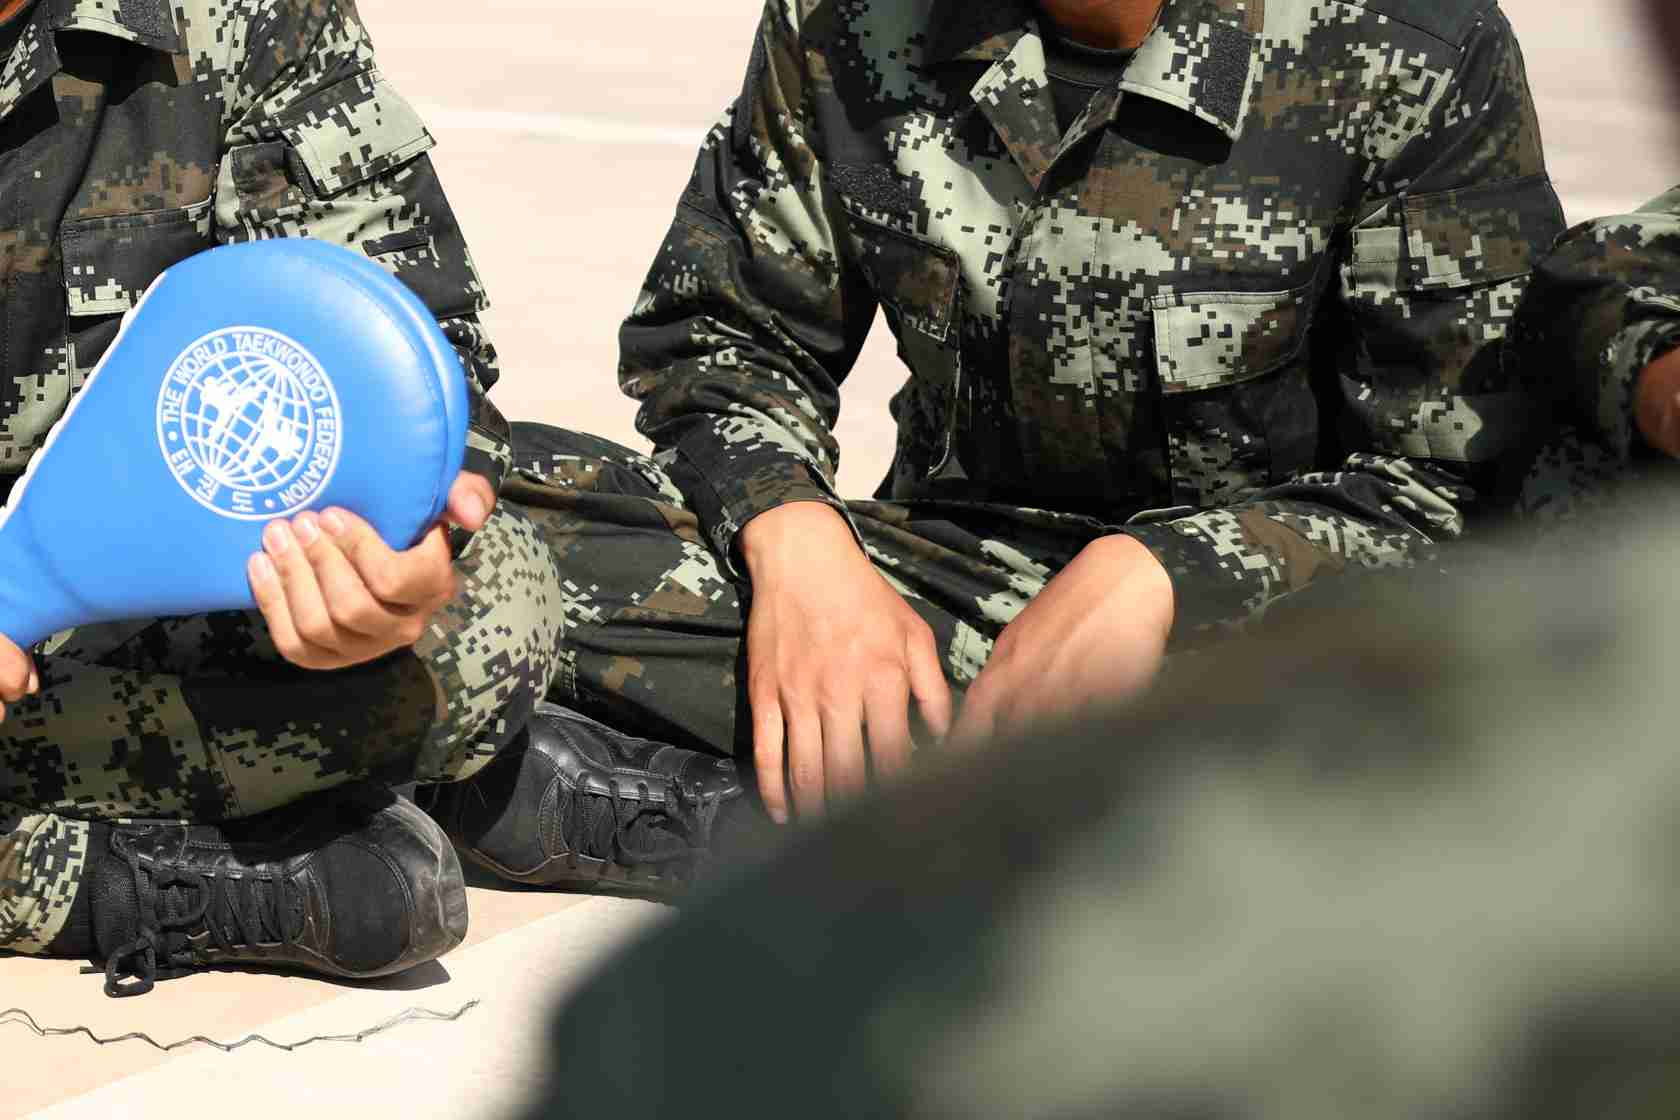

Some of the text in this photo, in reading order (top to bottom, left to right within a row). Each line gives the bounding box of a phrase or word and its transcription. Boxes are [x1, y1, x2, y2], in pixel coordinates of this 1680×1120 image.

[163, 333, 336, 505] THE WORLD TAEKWONDO FEDERATION
